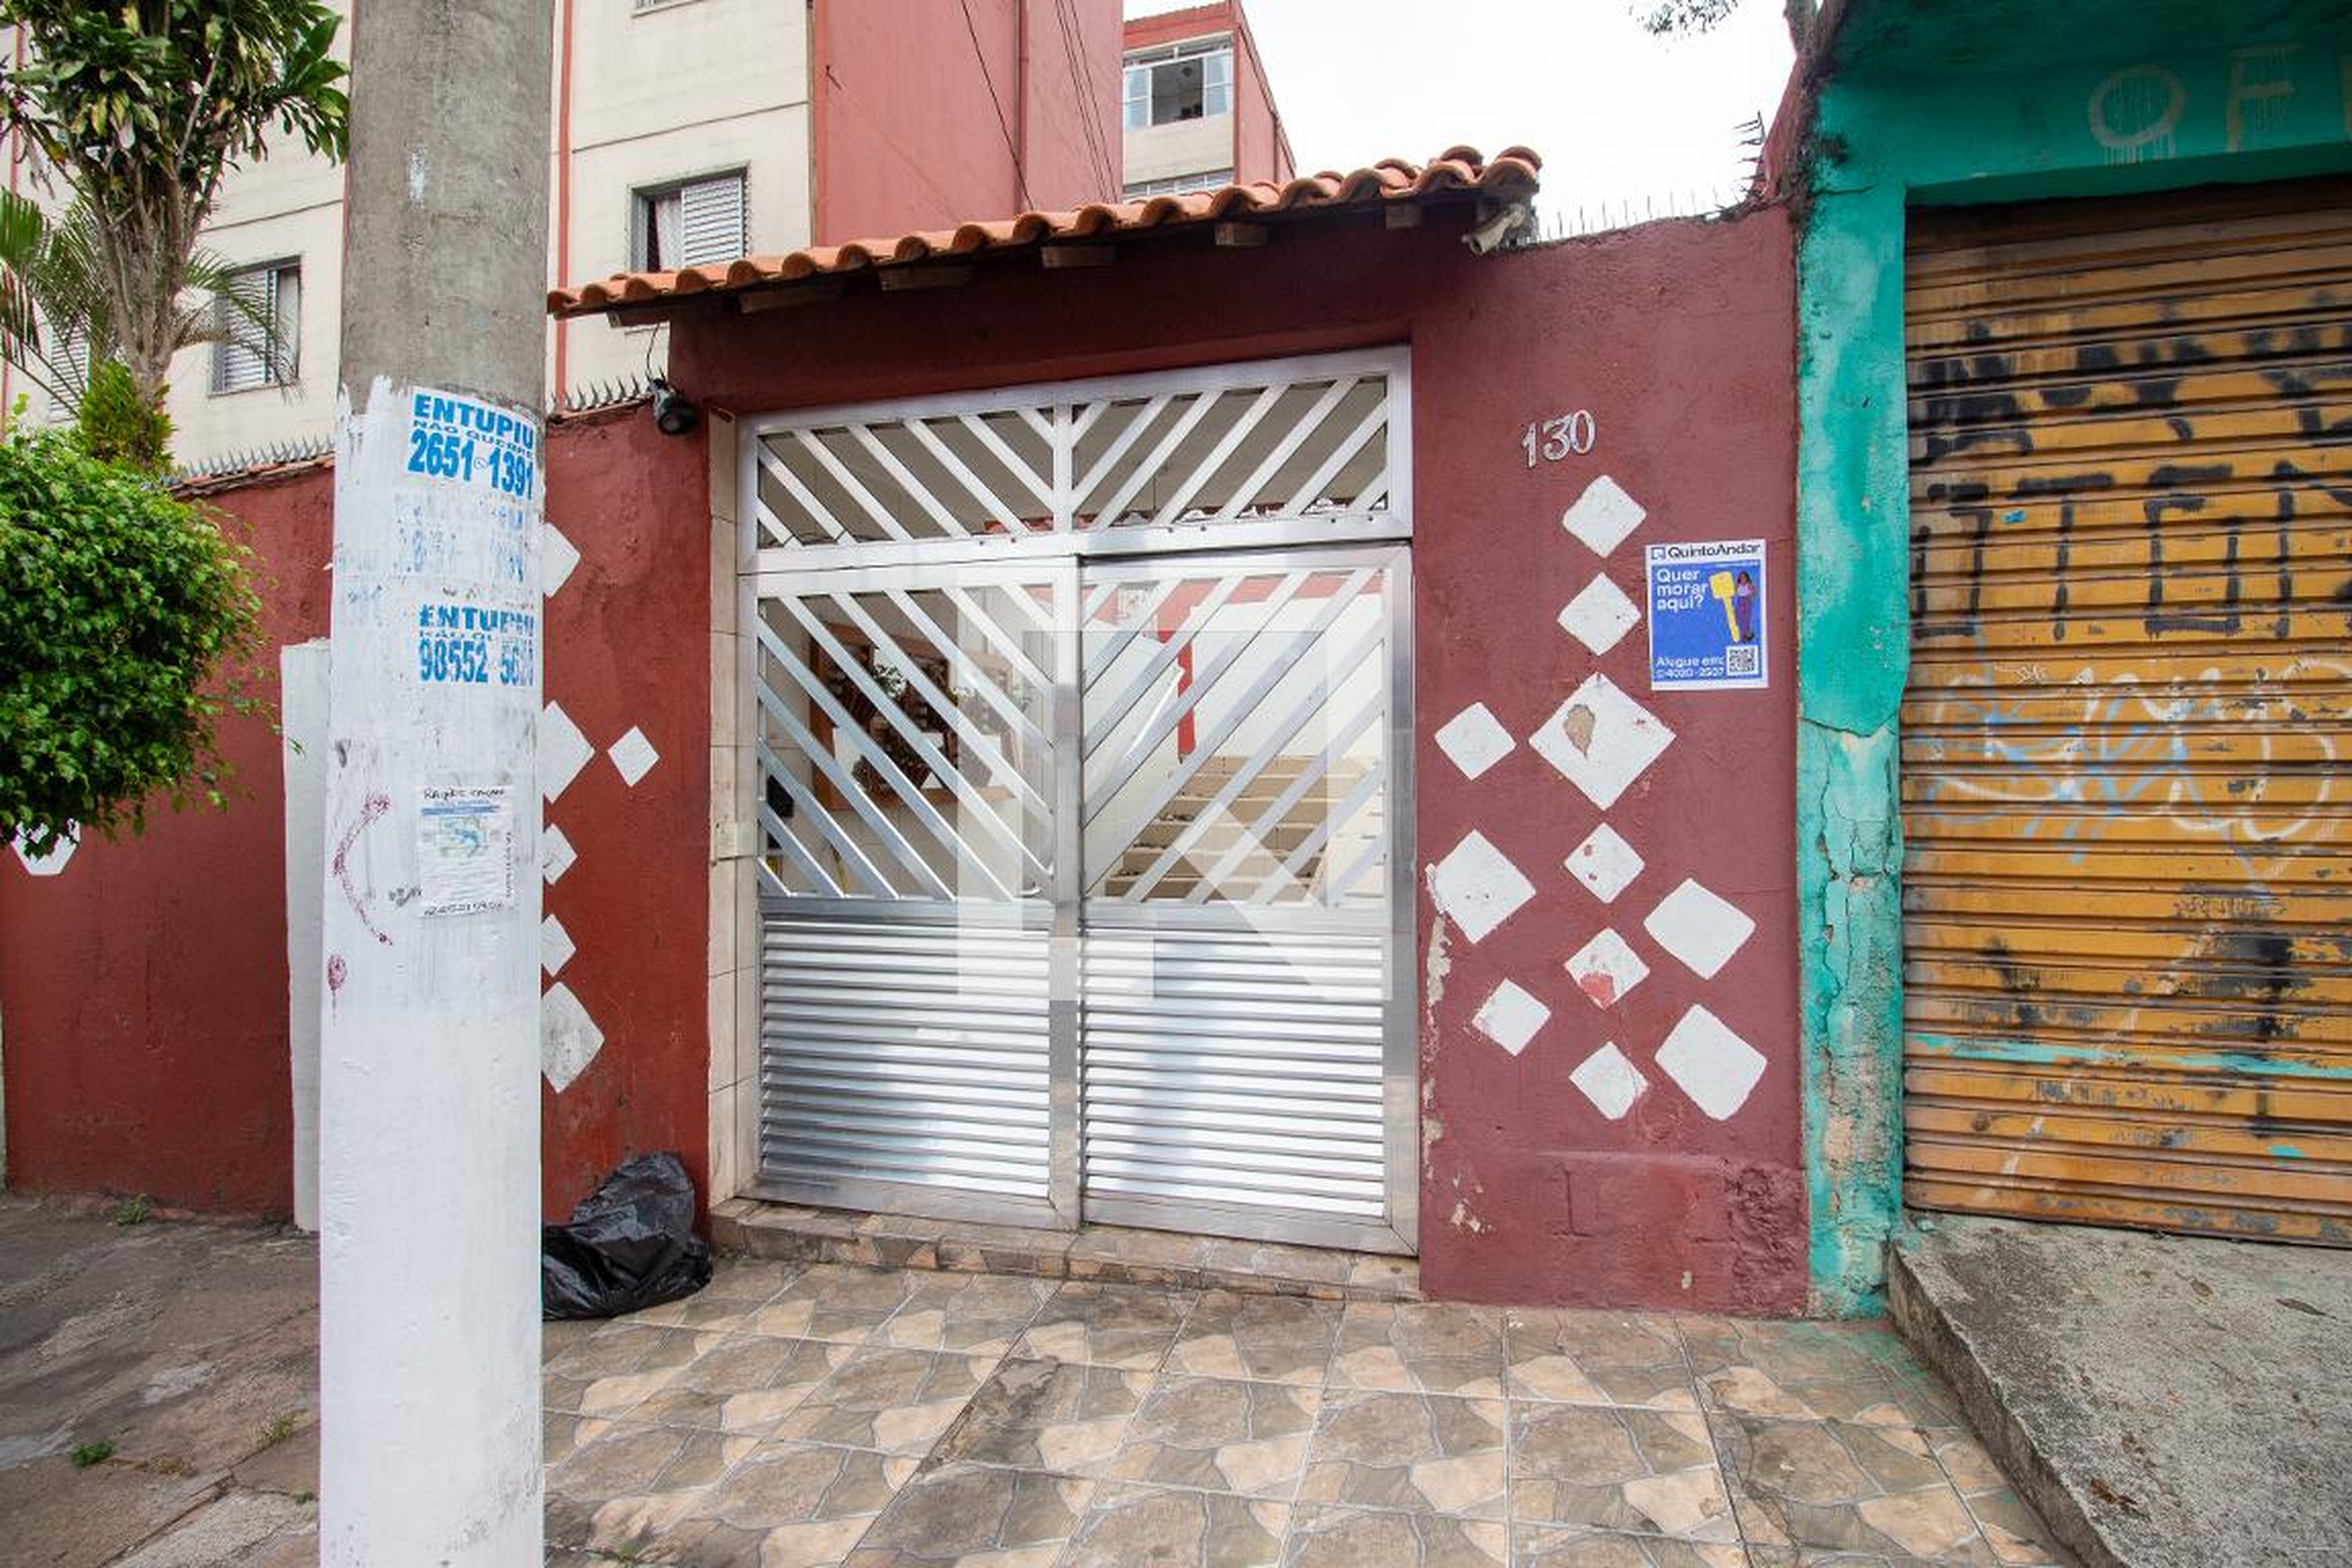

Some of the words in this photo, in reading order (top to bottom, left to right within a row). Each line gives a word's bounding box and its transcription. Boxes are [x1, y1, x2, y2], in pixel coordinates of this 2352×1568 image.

[415, 394, 533, 449] ENTUPIU
[1523, 410, 1595, 468] 130
[408, 428, 474, 482] 2651
[489, 447, 533, 500] 1391
[1668, 543, 1760, 558] QuintoAndar
[1657, 568, 1699, 582] Quer
[1657, 582, 1708, 596] morar
[1657, 594, 1703, 612] aqui?
